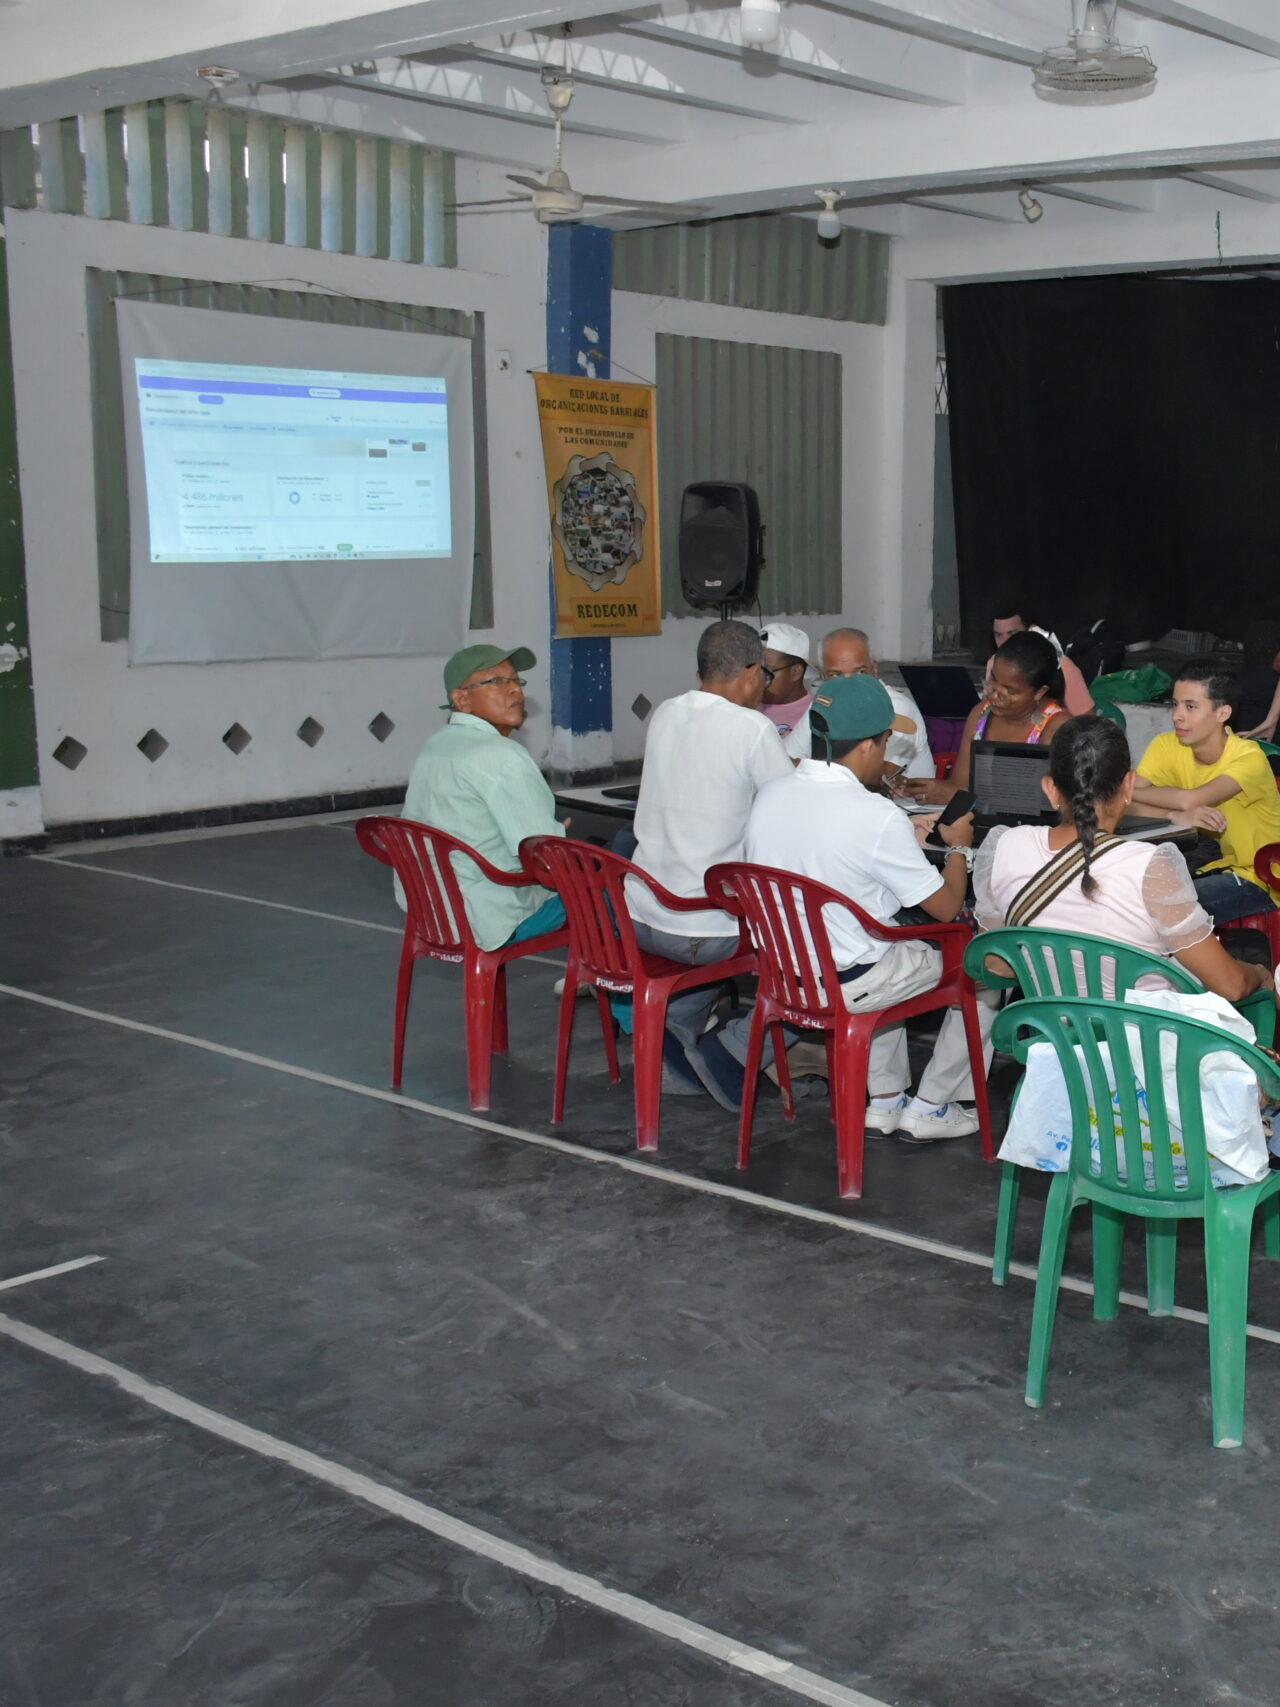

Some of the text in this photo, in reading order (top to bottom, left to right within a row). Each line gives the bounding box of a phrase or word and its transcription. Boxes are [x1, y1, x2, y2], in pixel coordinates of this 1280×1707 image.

[586, 390, 609, 402] LOCAL
[610, 393, 620, 403] DE
[540, 399, 608, 415] ORGANIZACIONES
[577, 603, 638, 619] REDECOM
